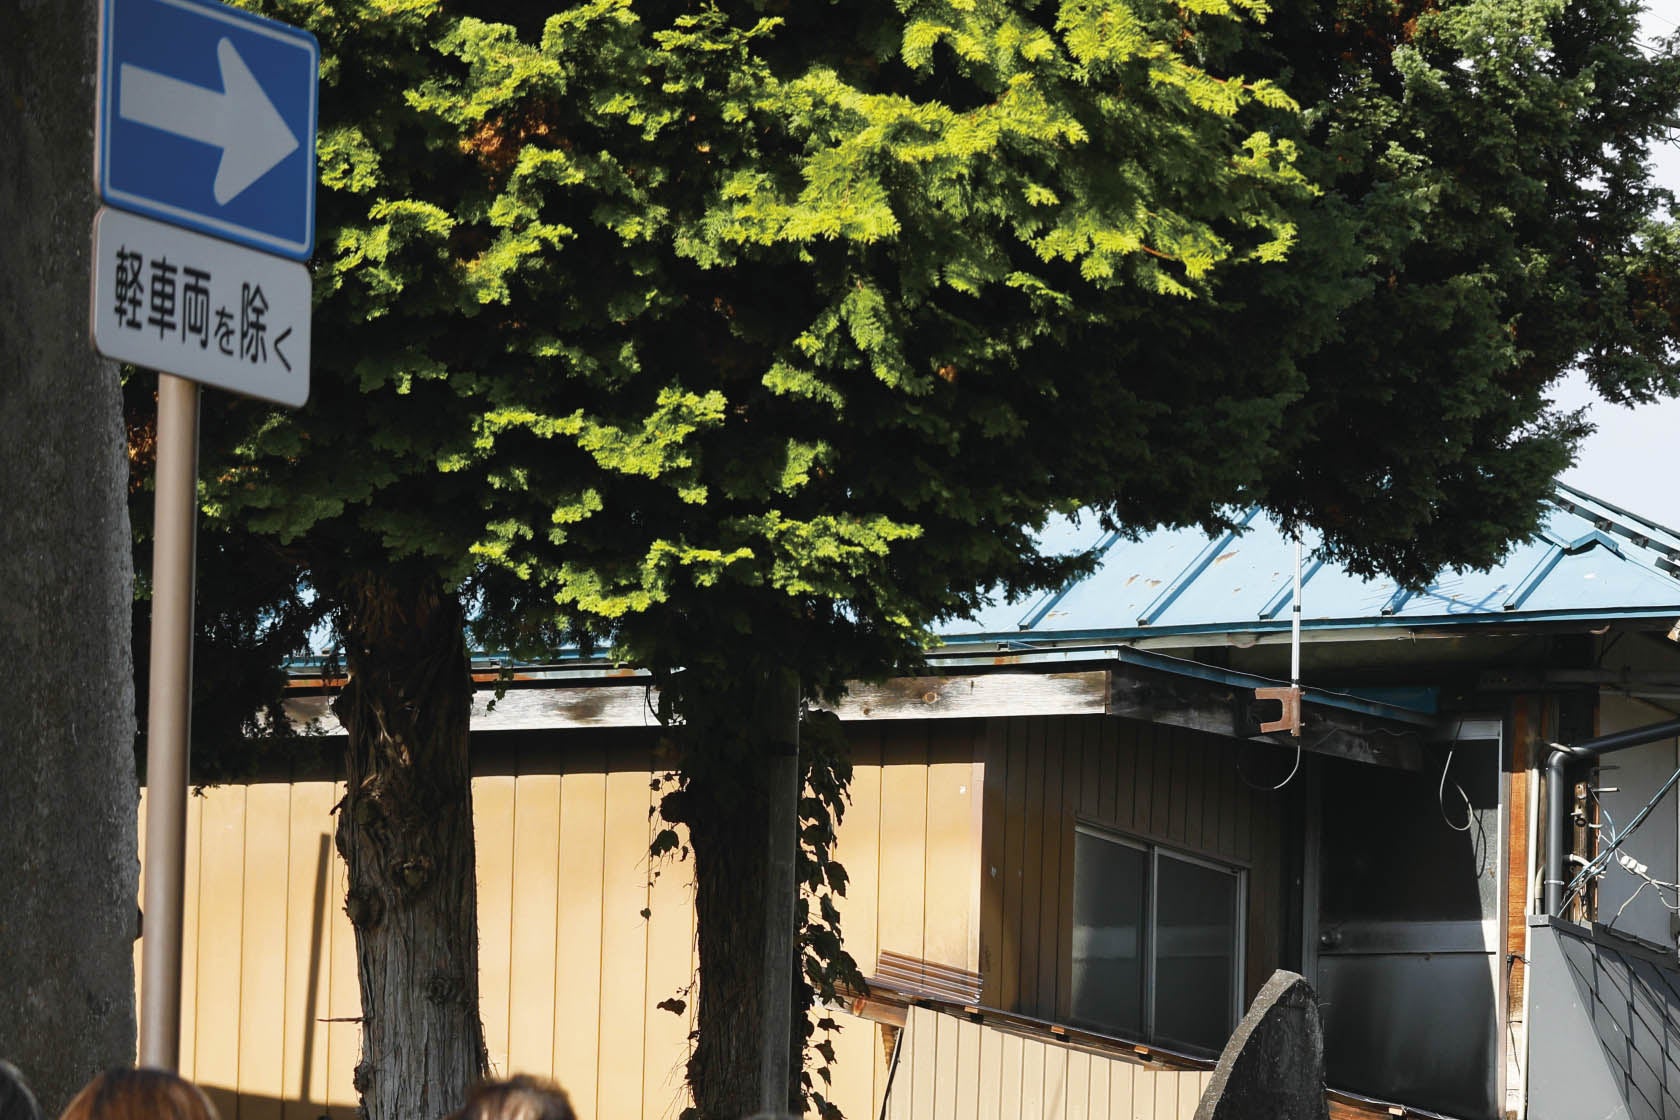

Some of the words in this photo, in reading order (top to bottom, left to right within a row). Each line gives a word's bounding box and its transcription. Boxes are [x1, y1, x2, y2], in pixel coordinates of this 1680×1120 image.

[113, 244, 293, 373] 軽車両を除く
